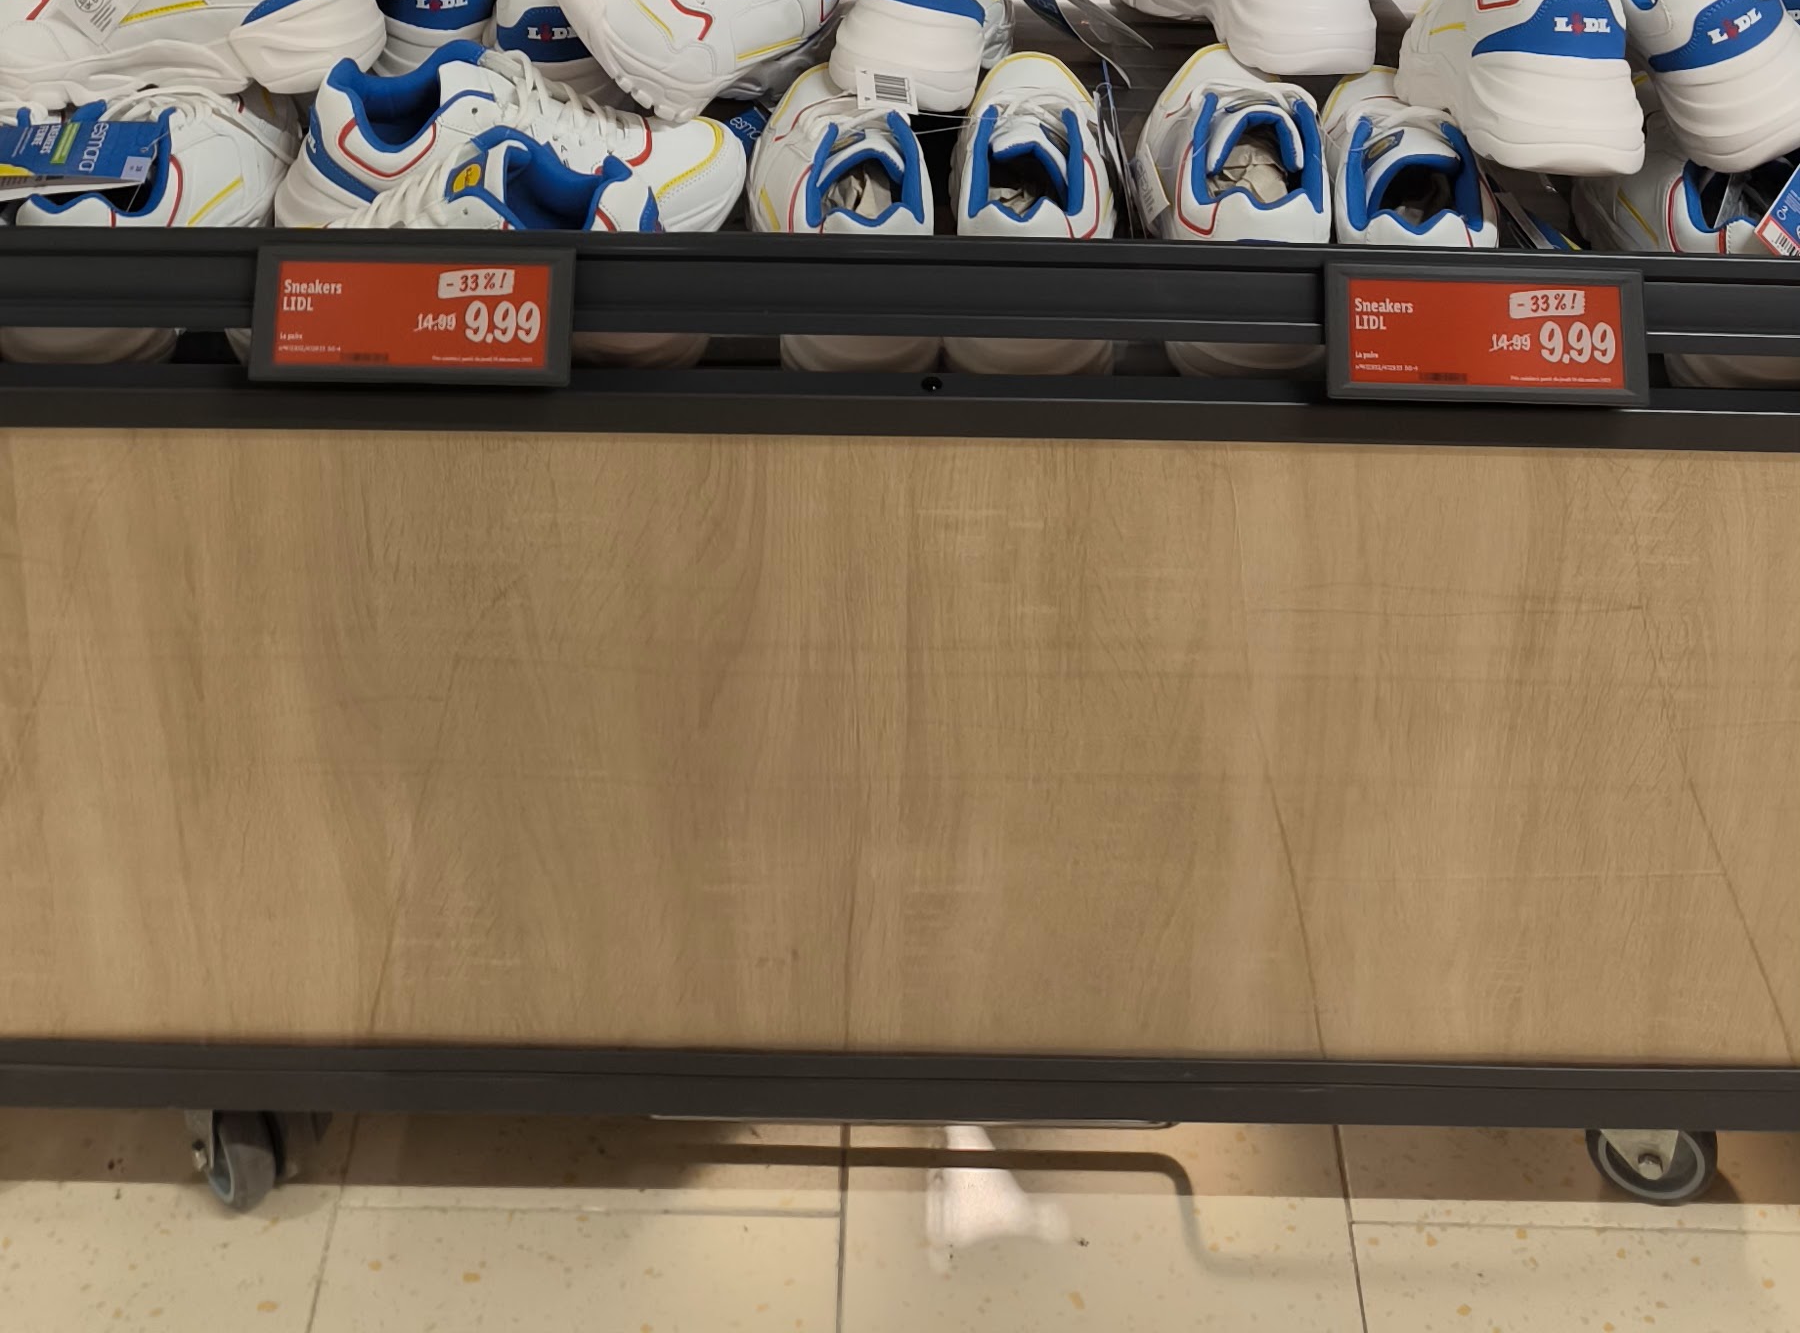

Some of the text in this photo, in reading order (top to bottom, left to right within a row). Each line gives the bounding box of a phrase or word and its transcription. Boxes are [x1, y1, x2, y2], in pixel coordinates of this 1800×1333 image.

[1554, 11, 1611, 35] LIDL
[1707, 7, 1764, 45] LIDL
[283, 278, 343, 295] Sneakers
[282, 295, 314, 312] LIDL
[1354, 297, 1414, 314] Sneakers
[415, 299, 542, 344] 14.99 9.99
[1354, 314, 1387, 331] LIDL
[1490, 320, 1616, 364] 14.99 9.99
